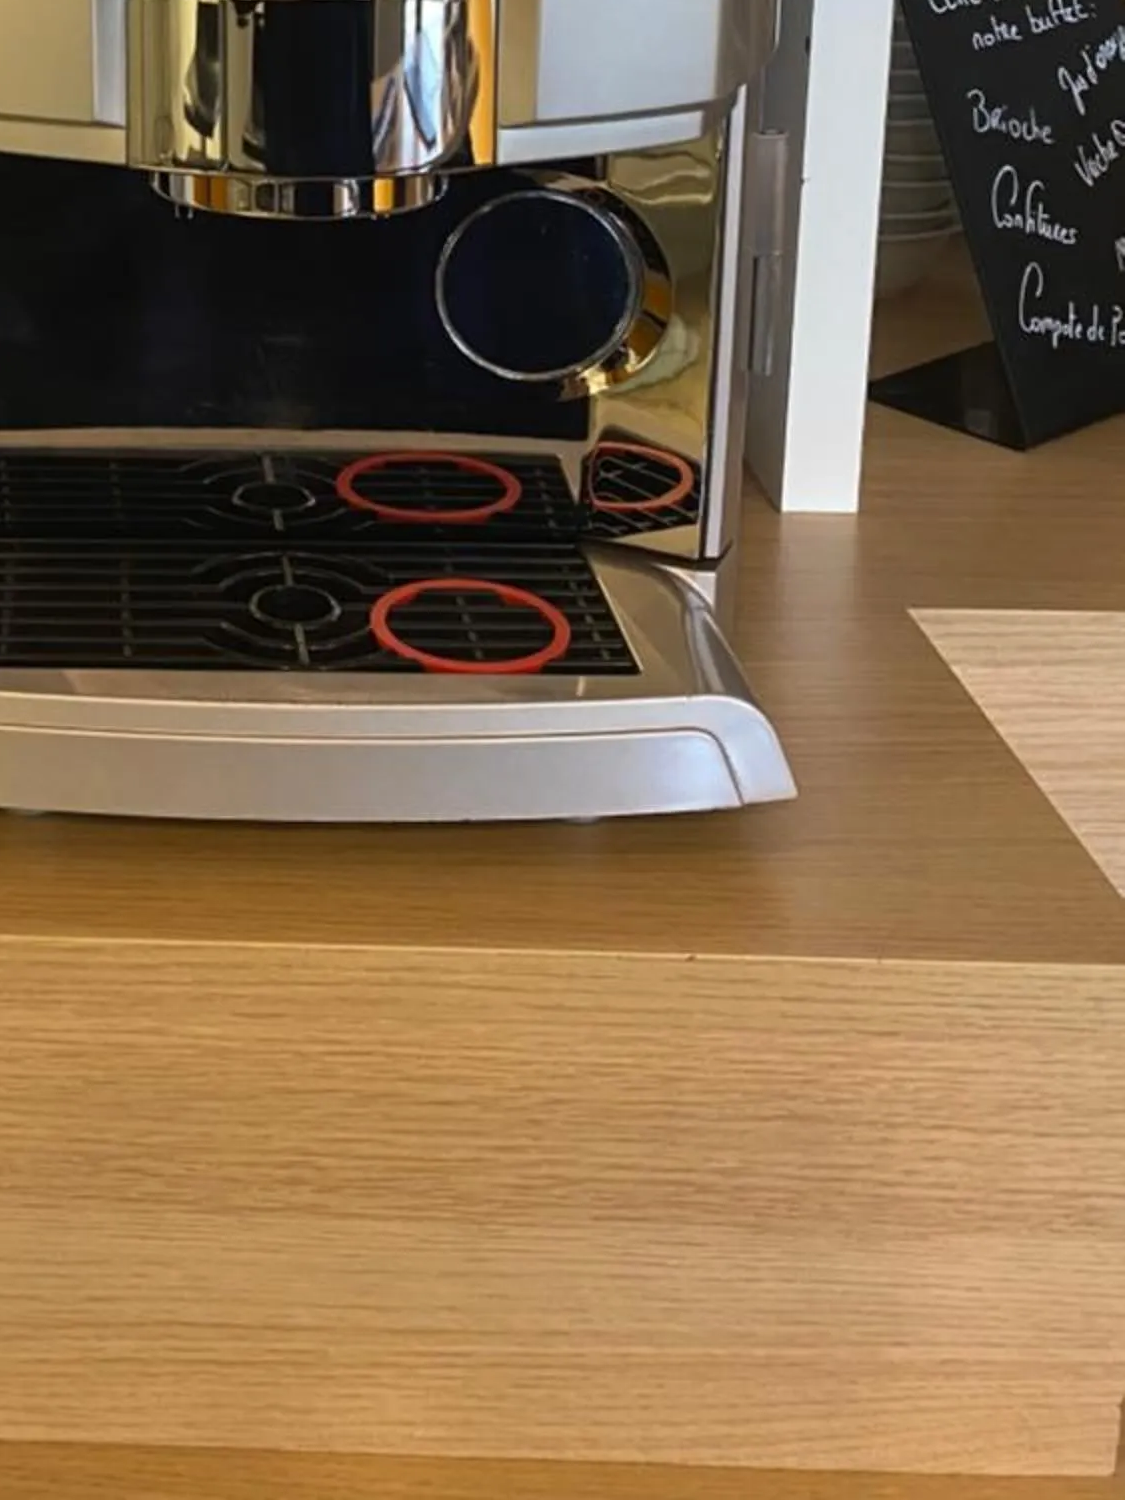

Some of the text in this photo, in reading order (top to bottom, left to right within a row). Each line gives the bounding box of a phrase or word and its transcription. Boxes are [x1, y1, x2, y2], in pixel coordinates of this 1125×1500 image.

[972, 14, 1023, 51] notre
[967, 88, 1056, 145] Brioche
[990, 163, 1078, 245] Confitures
[1018, 260, 1084, 350] Compote
[1086, 303, 1106, 342] de
